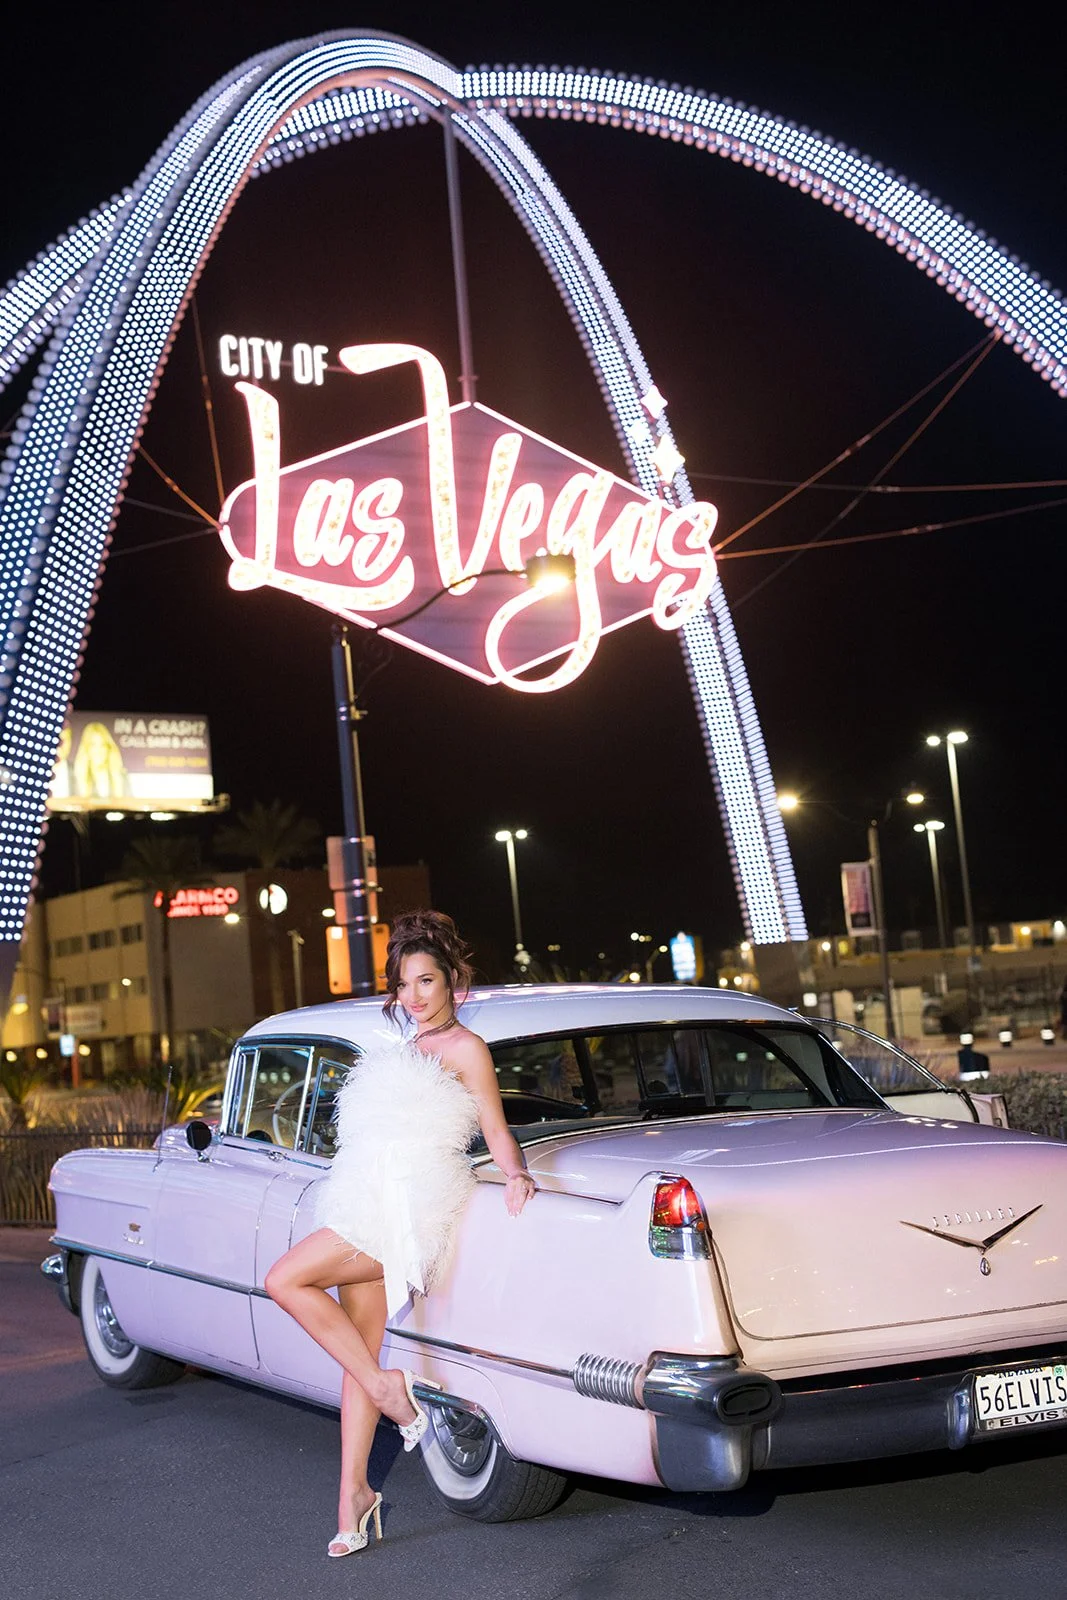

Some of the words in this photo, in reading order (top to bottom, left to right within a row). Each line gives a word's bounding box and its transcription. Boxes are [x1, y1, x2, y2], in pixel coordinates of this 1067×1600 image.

[219, 334, 282, 381] CITY
[292, 342, 329, 387] OF
[227, 380, 415, 612] Las
[338, 342, 719, 694] Vegas
[113, 718, 132, 735] IN
[133, 719, 148, 736] A
[148, 719, 206, 738] CRASH?
[980, 1375, 1067, 1415] 56ELVIS
[1000, 1410, 1059, 1427] ELVIS
